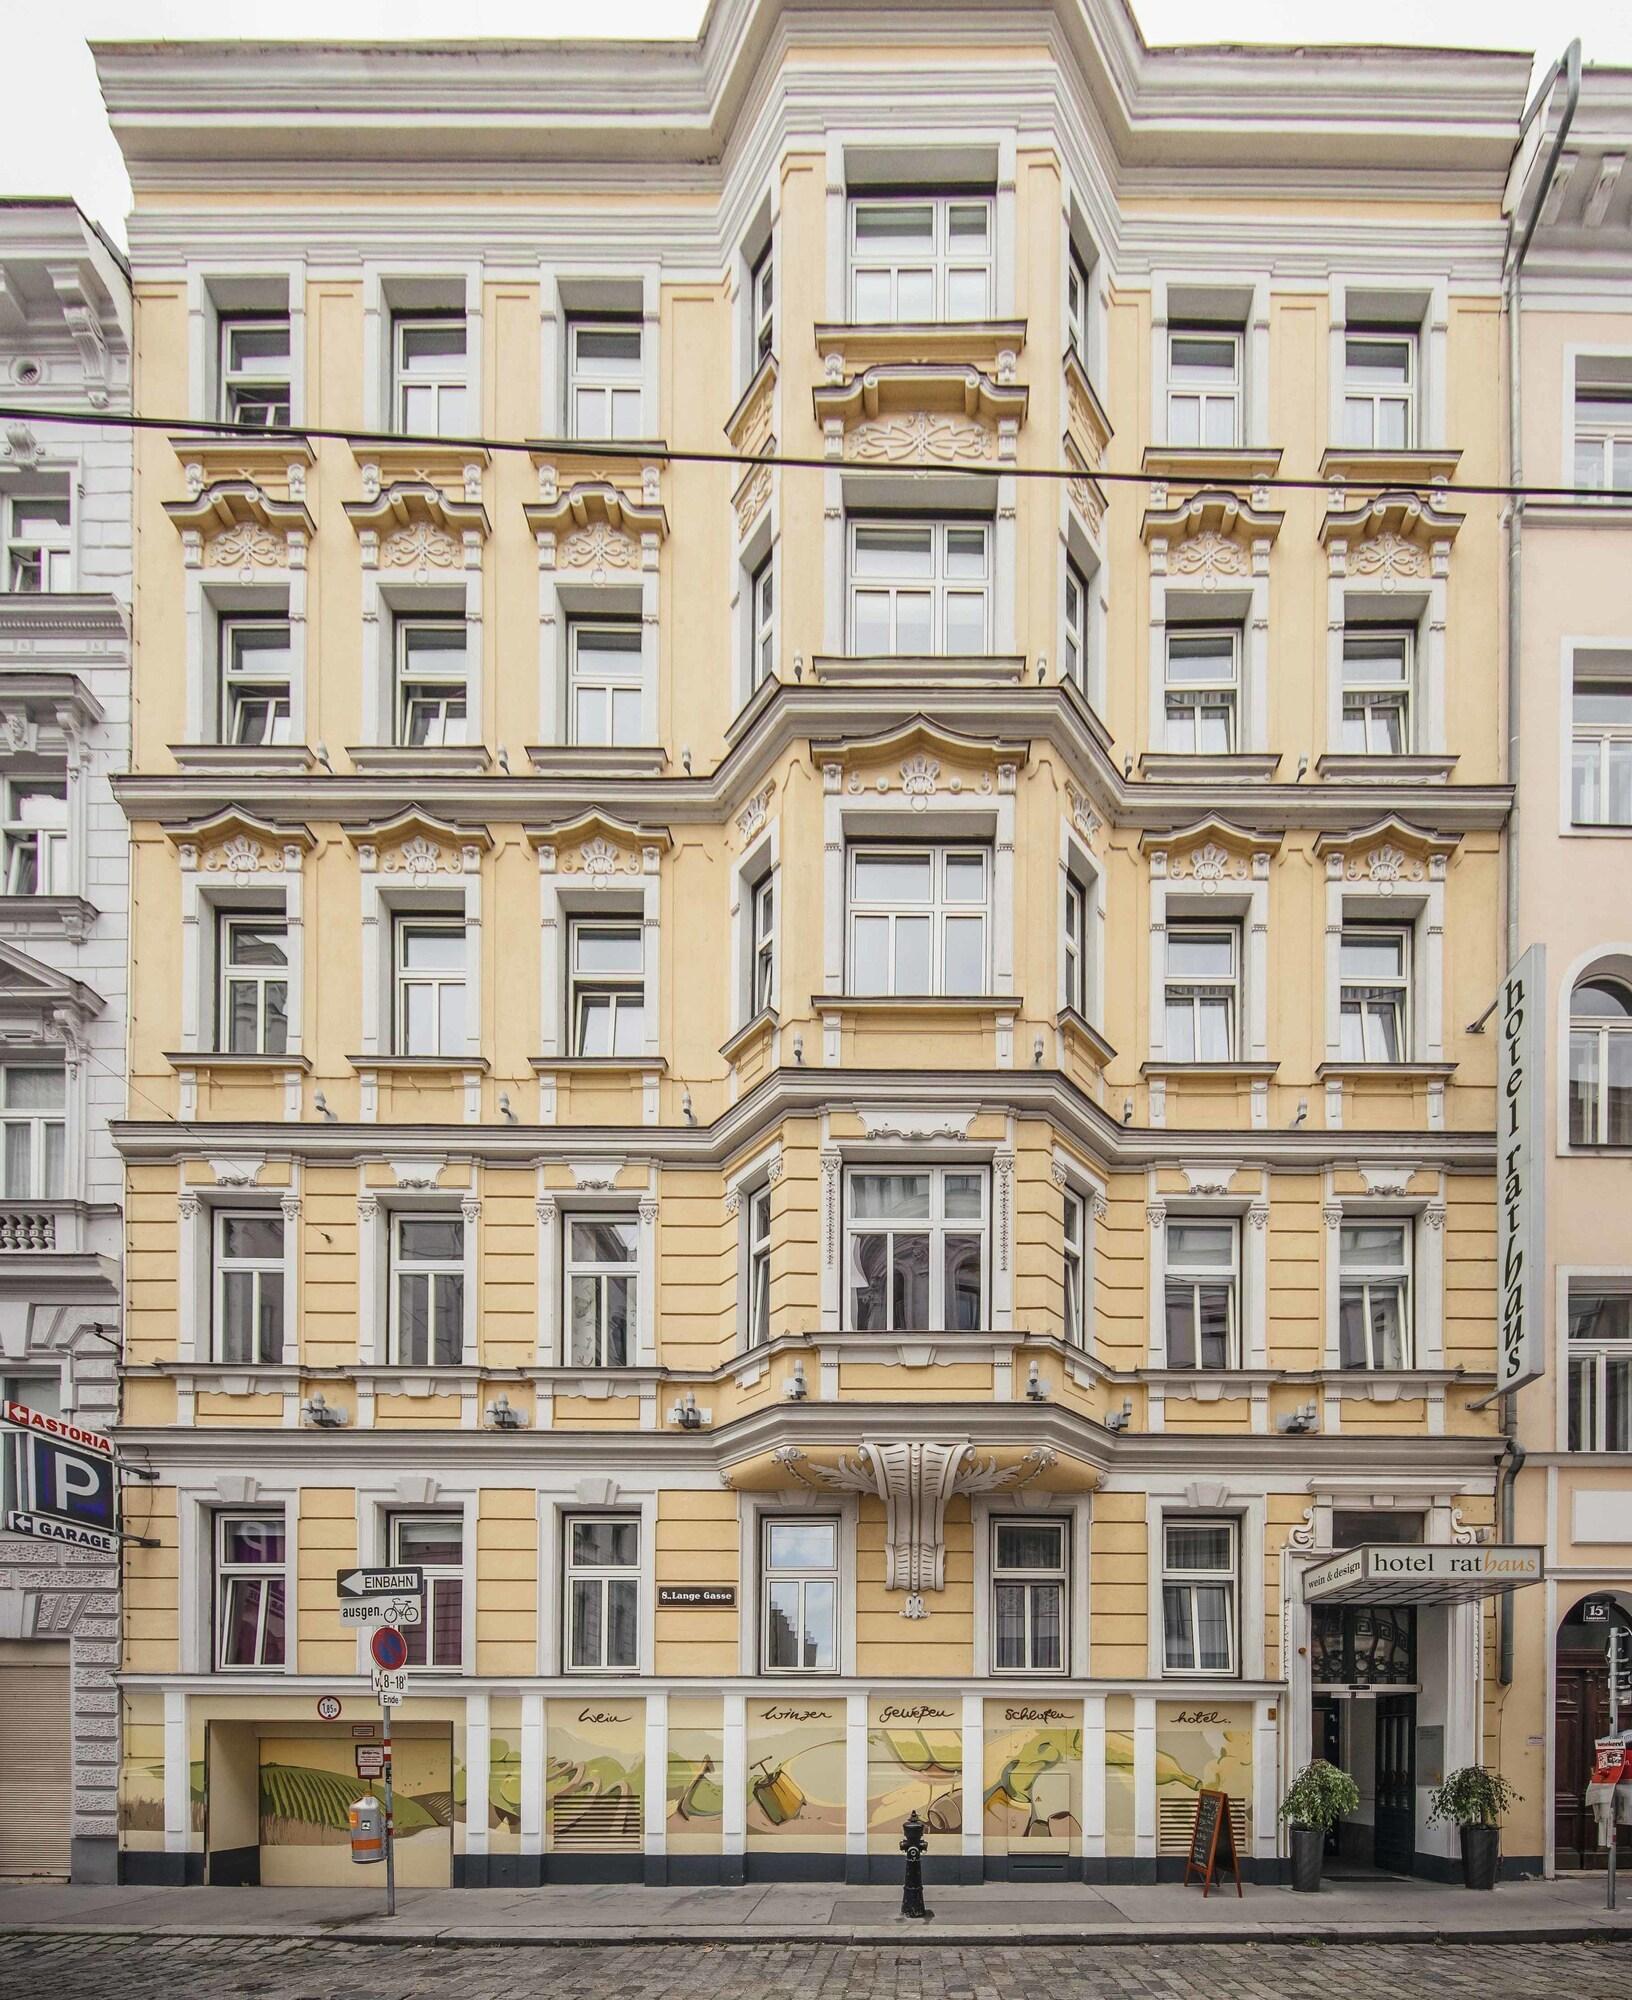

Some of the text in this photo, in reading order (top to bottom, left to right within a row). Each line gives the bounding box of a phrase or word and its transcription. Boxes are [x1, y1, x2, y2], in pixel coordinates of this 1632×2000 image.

[1502, 978, 1525, 1380] hotel rathaus
[31, 1413, 111, 1452] ASTORIA
[54, 1451, 100, 1511] P
[39, 1522, 112, 1550] GARAGE
[1307, 1560, 1361, 1590] wein & design
[1373, 1550, 1537, 1576] hotel rathaus
[364, 1575, 414, 1589] EINBAHN
[672, 1591, 701, 1602] Lange
[703, 1591, 732, 1600] Gasse
[342, 1606, 384, 1621] ausgen.
[1589, 1605, 1604, 1616] 15
[383, 1694, 399, 1704] Ende
